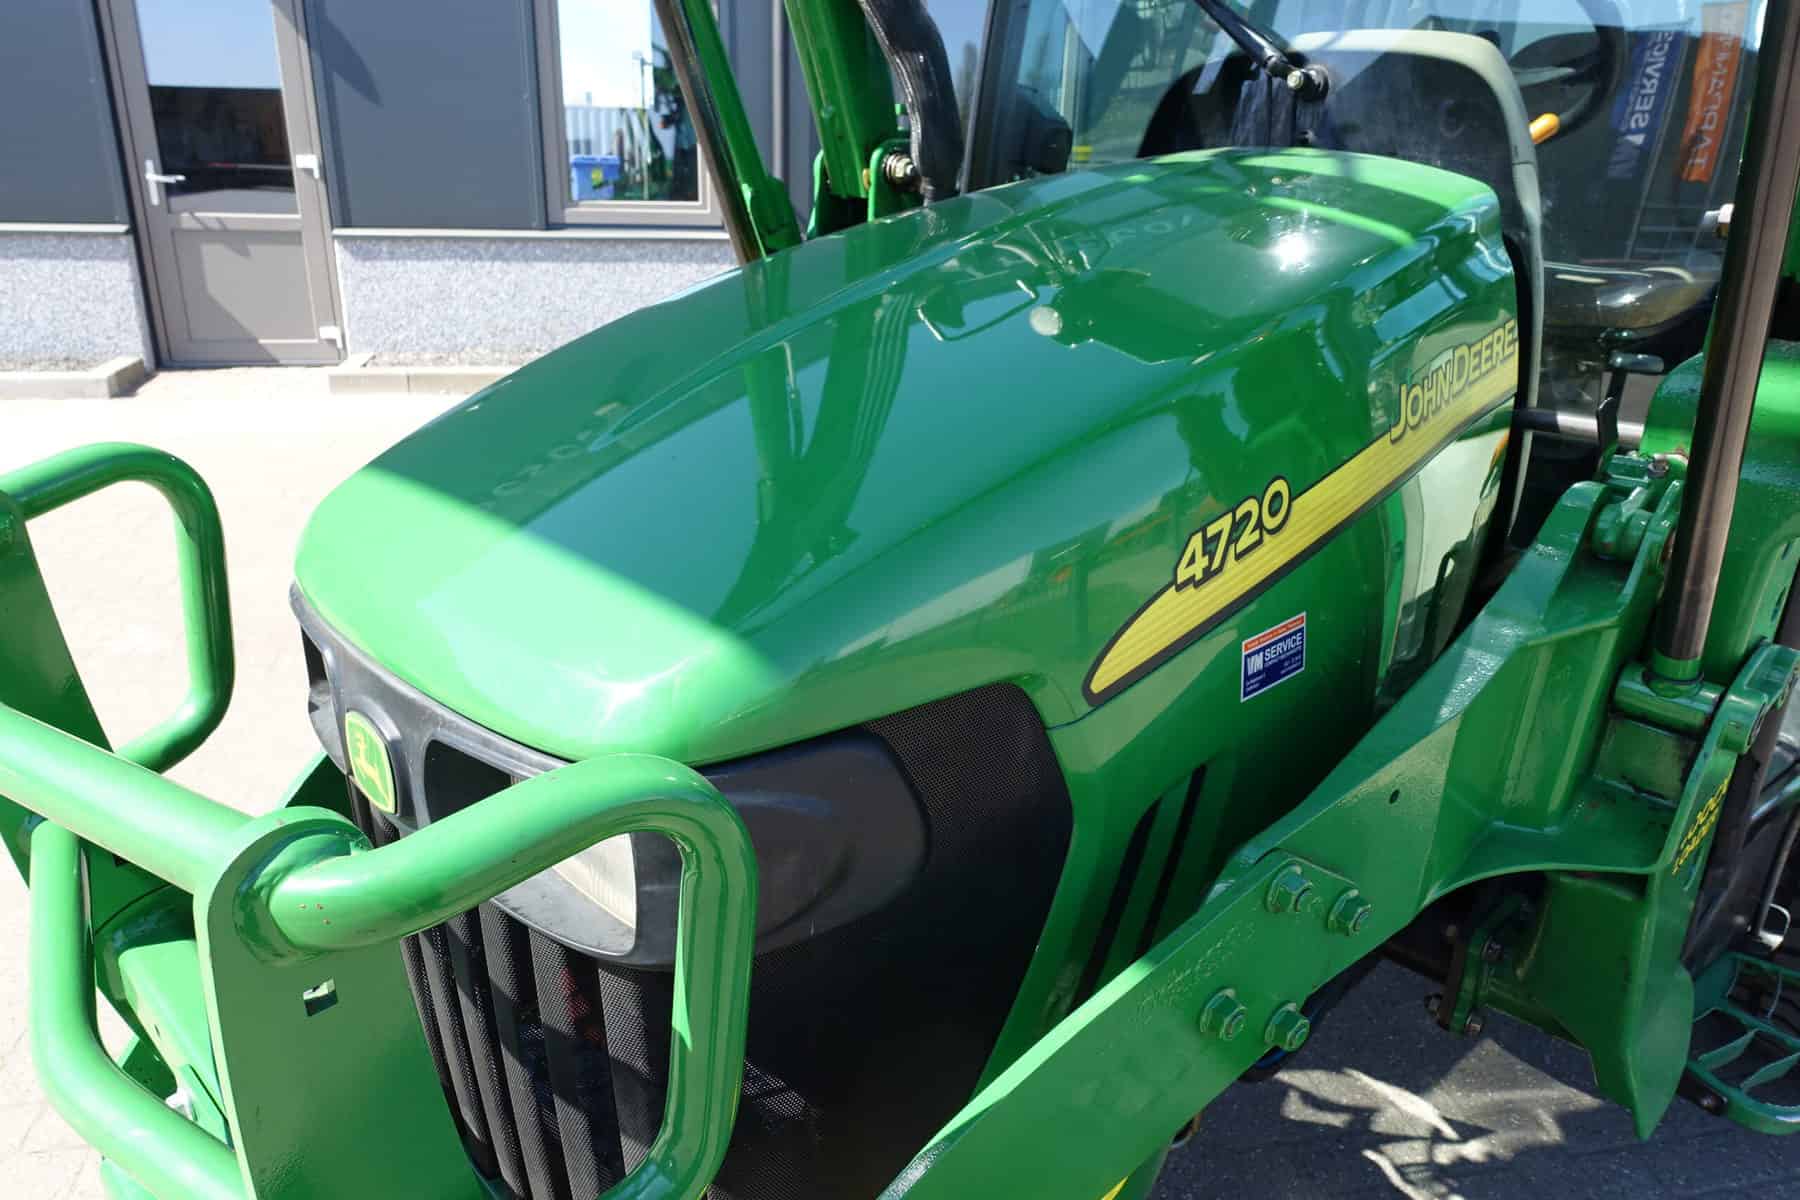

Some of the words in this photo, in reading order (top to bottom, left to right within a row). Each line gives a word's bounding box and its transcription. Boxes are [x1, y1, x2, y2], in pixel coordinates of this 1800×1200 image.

[1389, 356, 1456, 444] JOHN
[1451, 319, 1519, 398] DEERE
[1176, 477, 1290, 588] 4720
[1264, 632, 1303, 661] SERVICE
